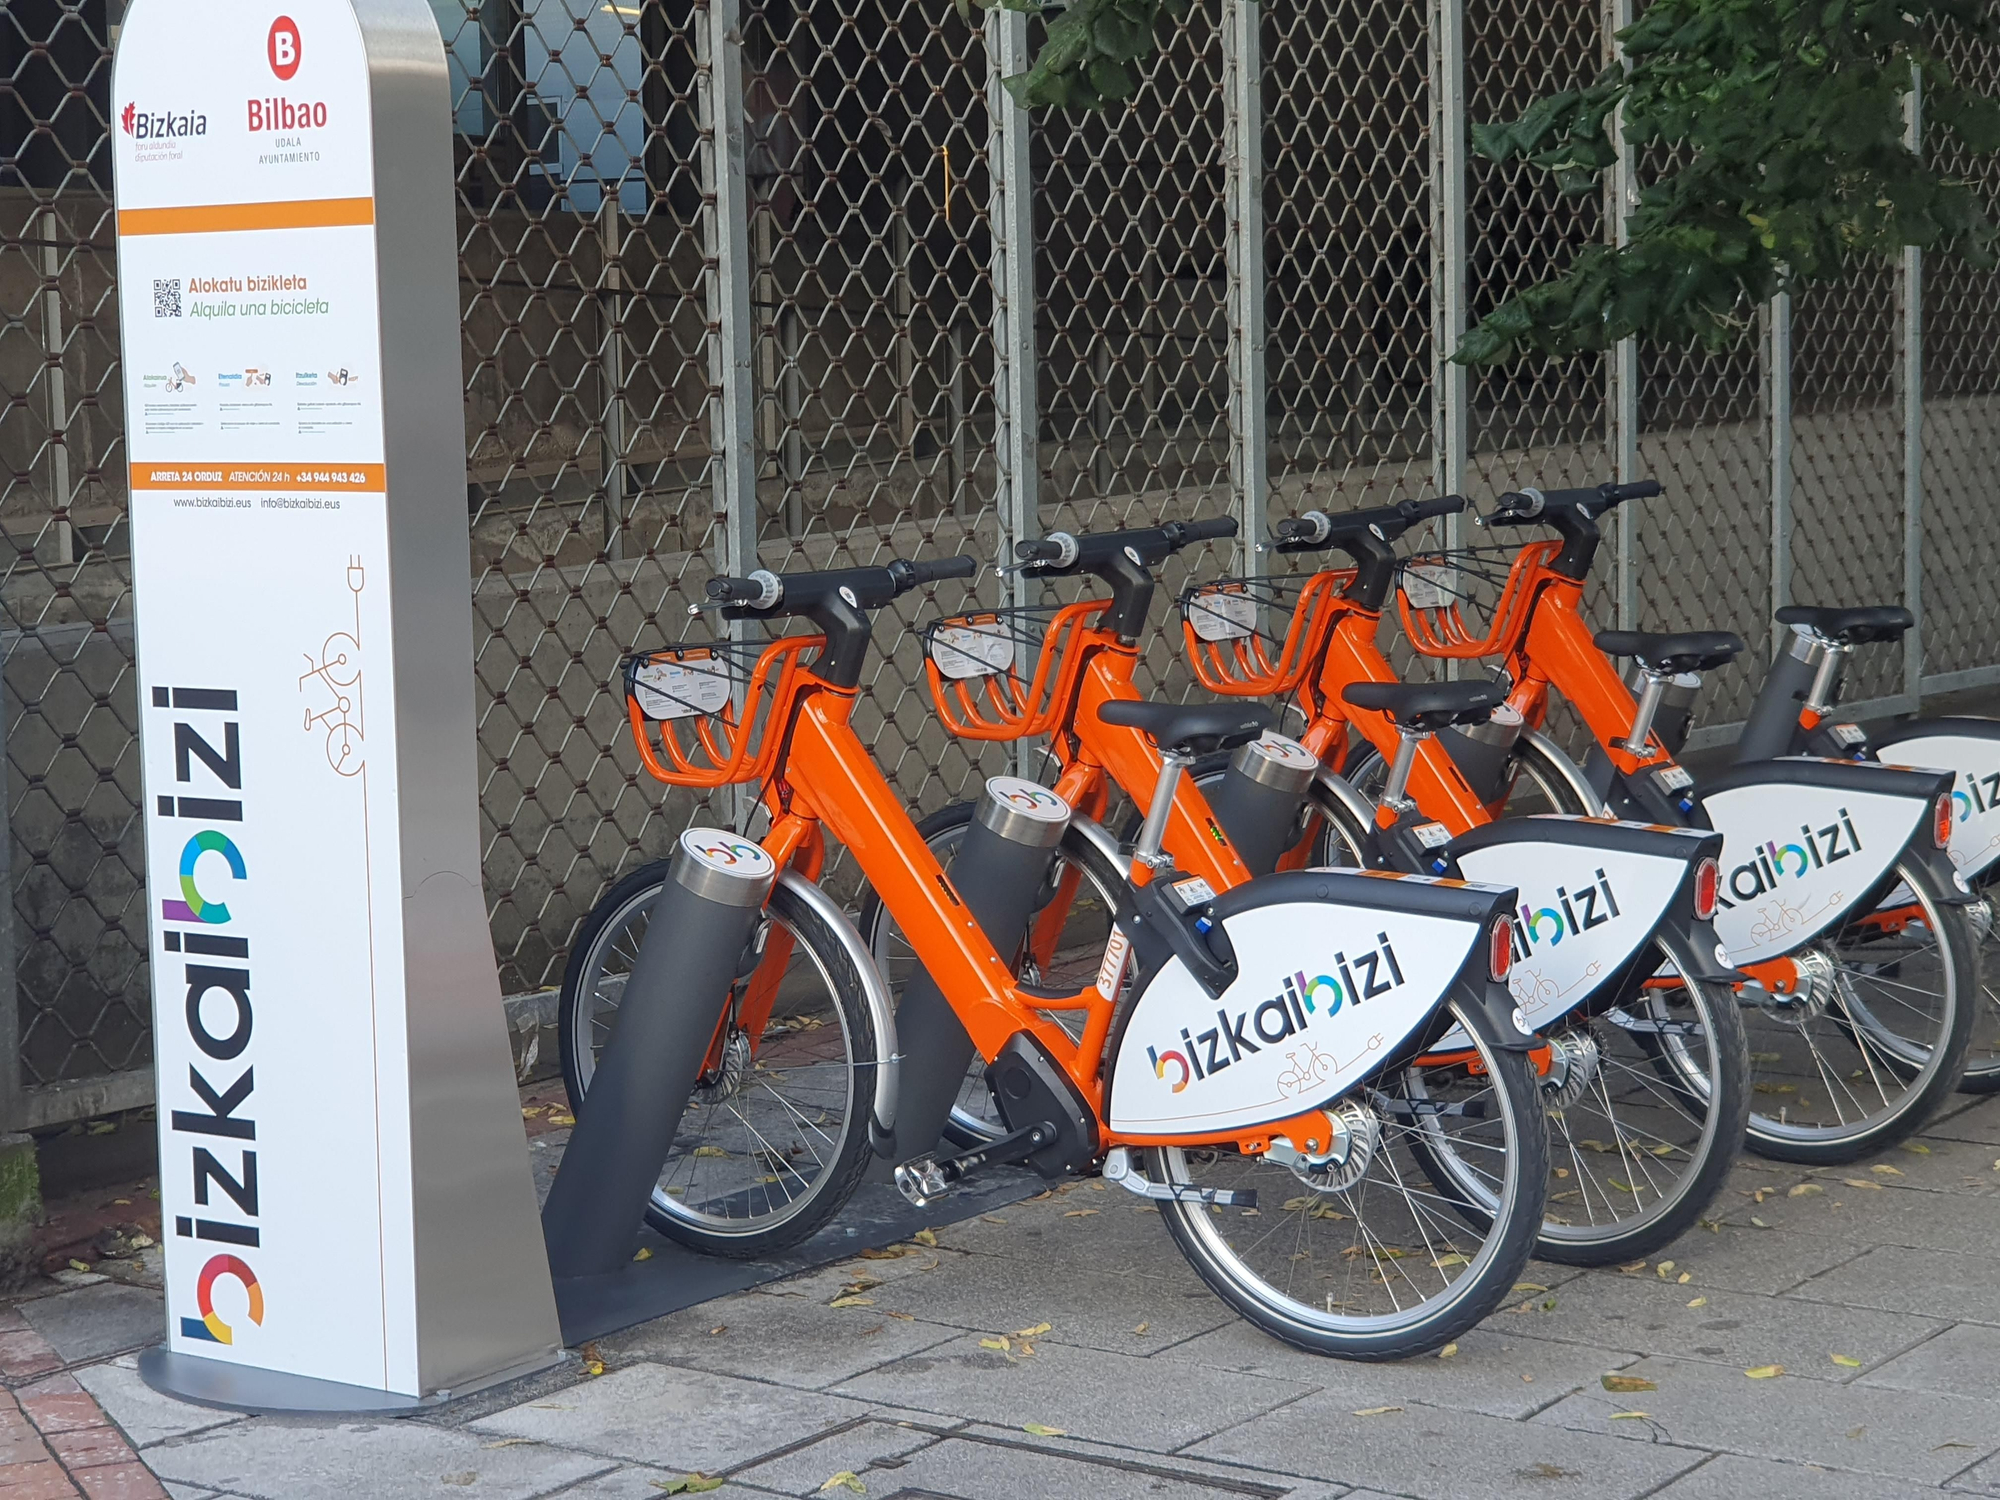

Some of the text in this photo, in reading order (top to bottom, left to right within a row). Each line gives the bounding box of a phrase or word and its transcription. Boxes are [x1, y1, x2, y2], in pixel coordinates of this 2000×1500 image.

[136, 109, 207, 139] Bizkaia
[247, 97, 327, 132] Bilbao
[275, 136, 302, 148] UDALA
[258, 151, 320, 165] AYUNTAMIENTO
[188, 274, 307, 294] Alokatu bizikleta
[190, 298, 329, 320] Alquila una bicicleta
[150, 469, 366, 483] ARRETA 24 ORDUZ ATENCIÓN 24 h +34 944 943 426
[173, 497, 341, 510] www.bizkaibizi.eus info@bizkaibizi.eus
[1715, 807, 1863, 911] aibizi
[1101, 929, 1128, 990] 377701
[151, 685, 265, 1345] bizkaibizi
[1146, 931, 1406, 1093] bizkaibizi
